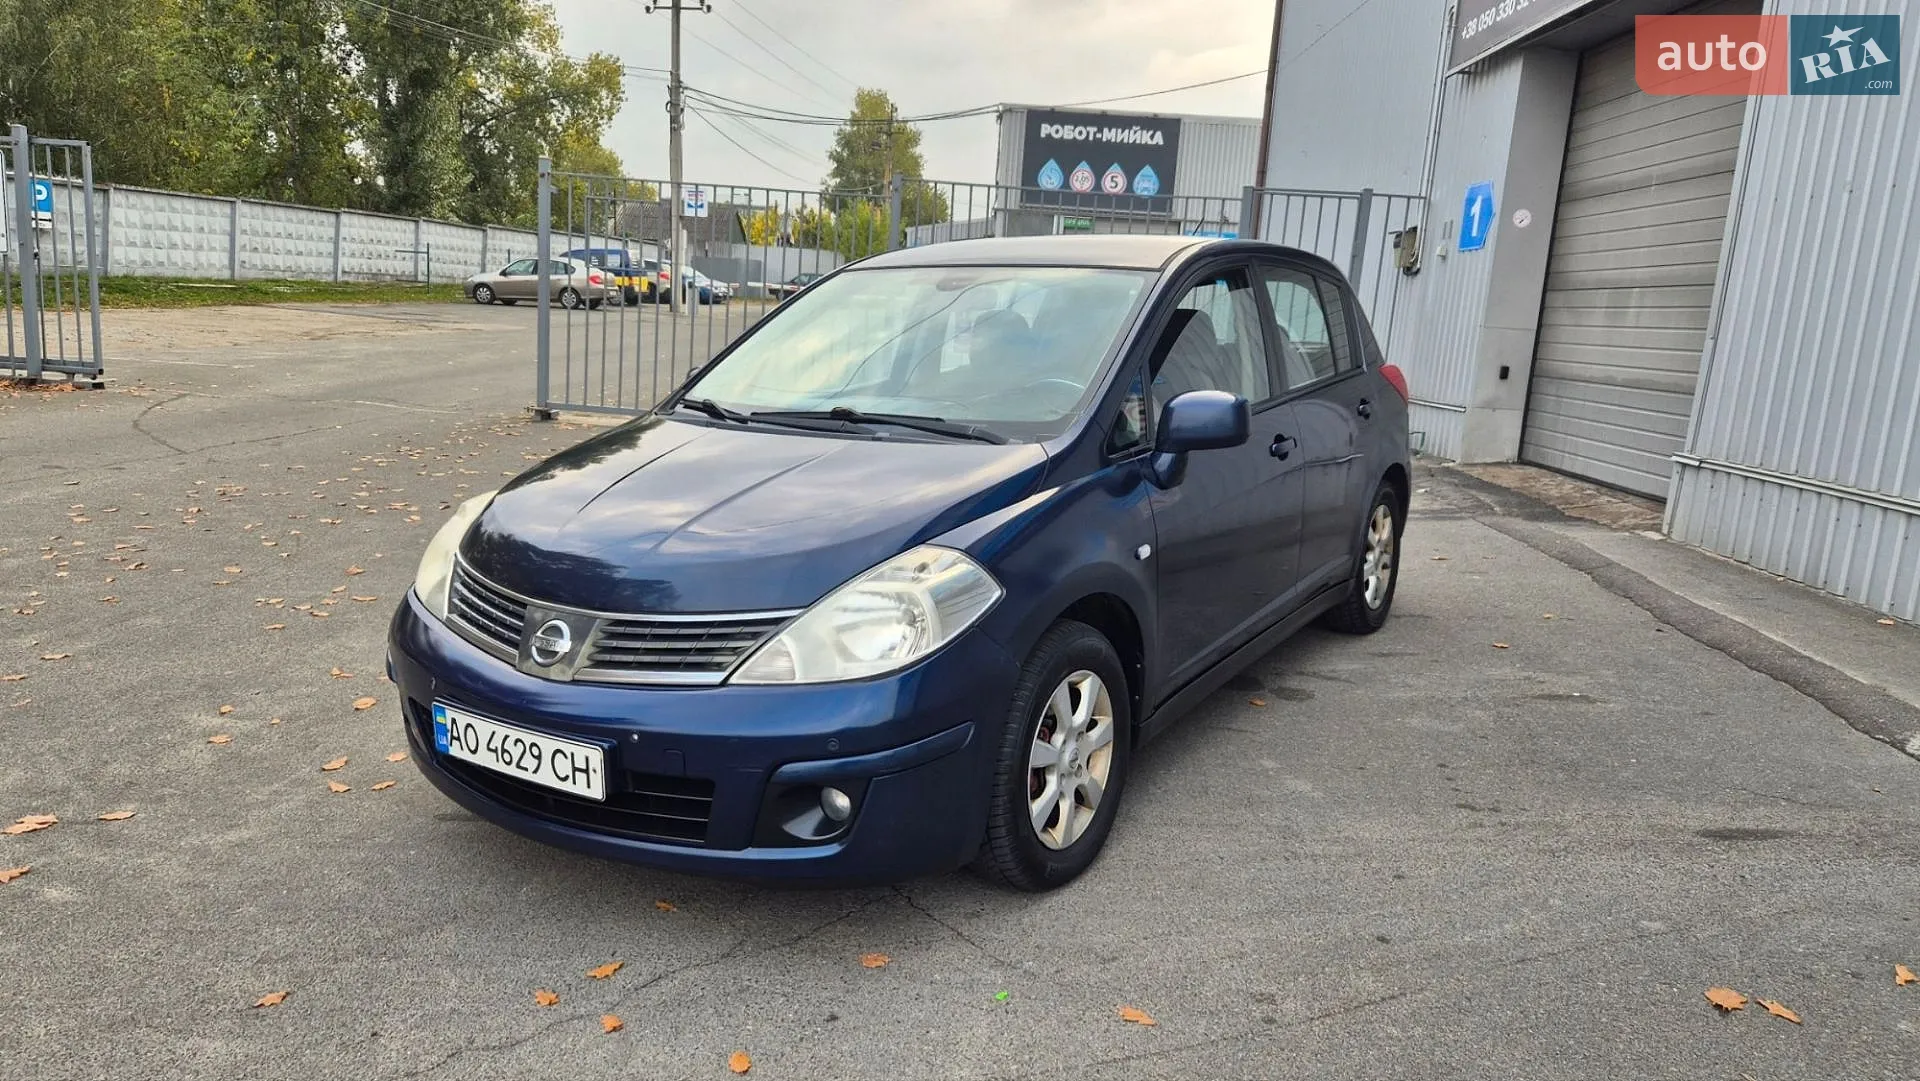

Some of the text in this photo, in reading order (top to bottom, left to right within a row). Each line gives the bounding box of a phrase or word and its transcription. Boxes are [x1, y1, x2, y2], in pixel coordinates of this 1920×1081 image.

[1461, 17, 1478, 39] +38
[1478, 7, 1496, 32] 050
[1040, 123, 1164, 145] РОБОТ-МИЙКА
[1110, 175, 1119, 189] 5
[1470, 195, 1483, 237] 1
[450, 717, 591, 789] AO 4629 CH
